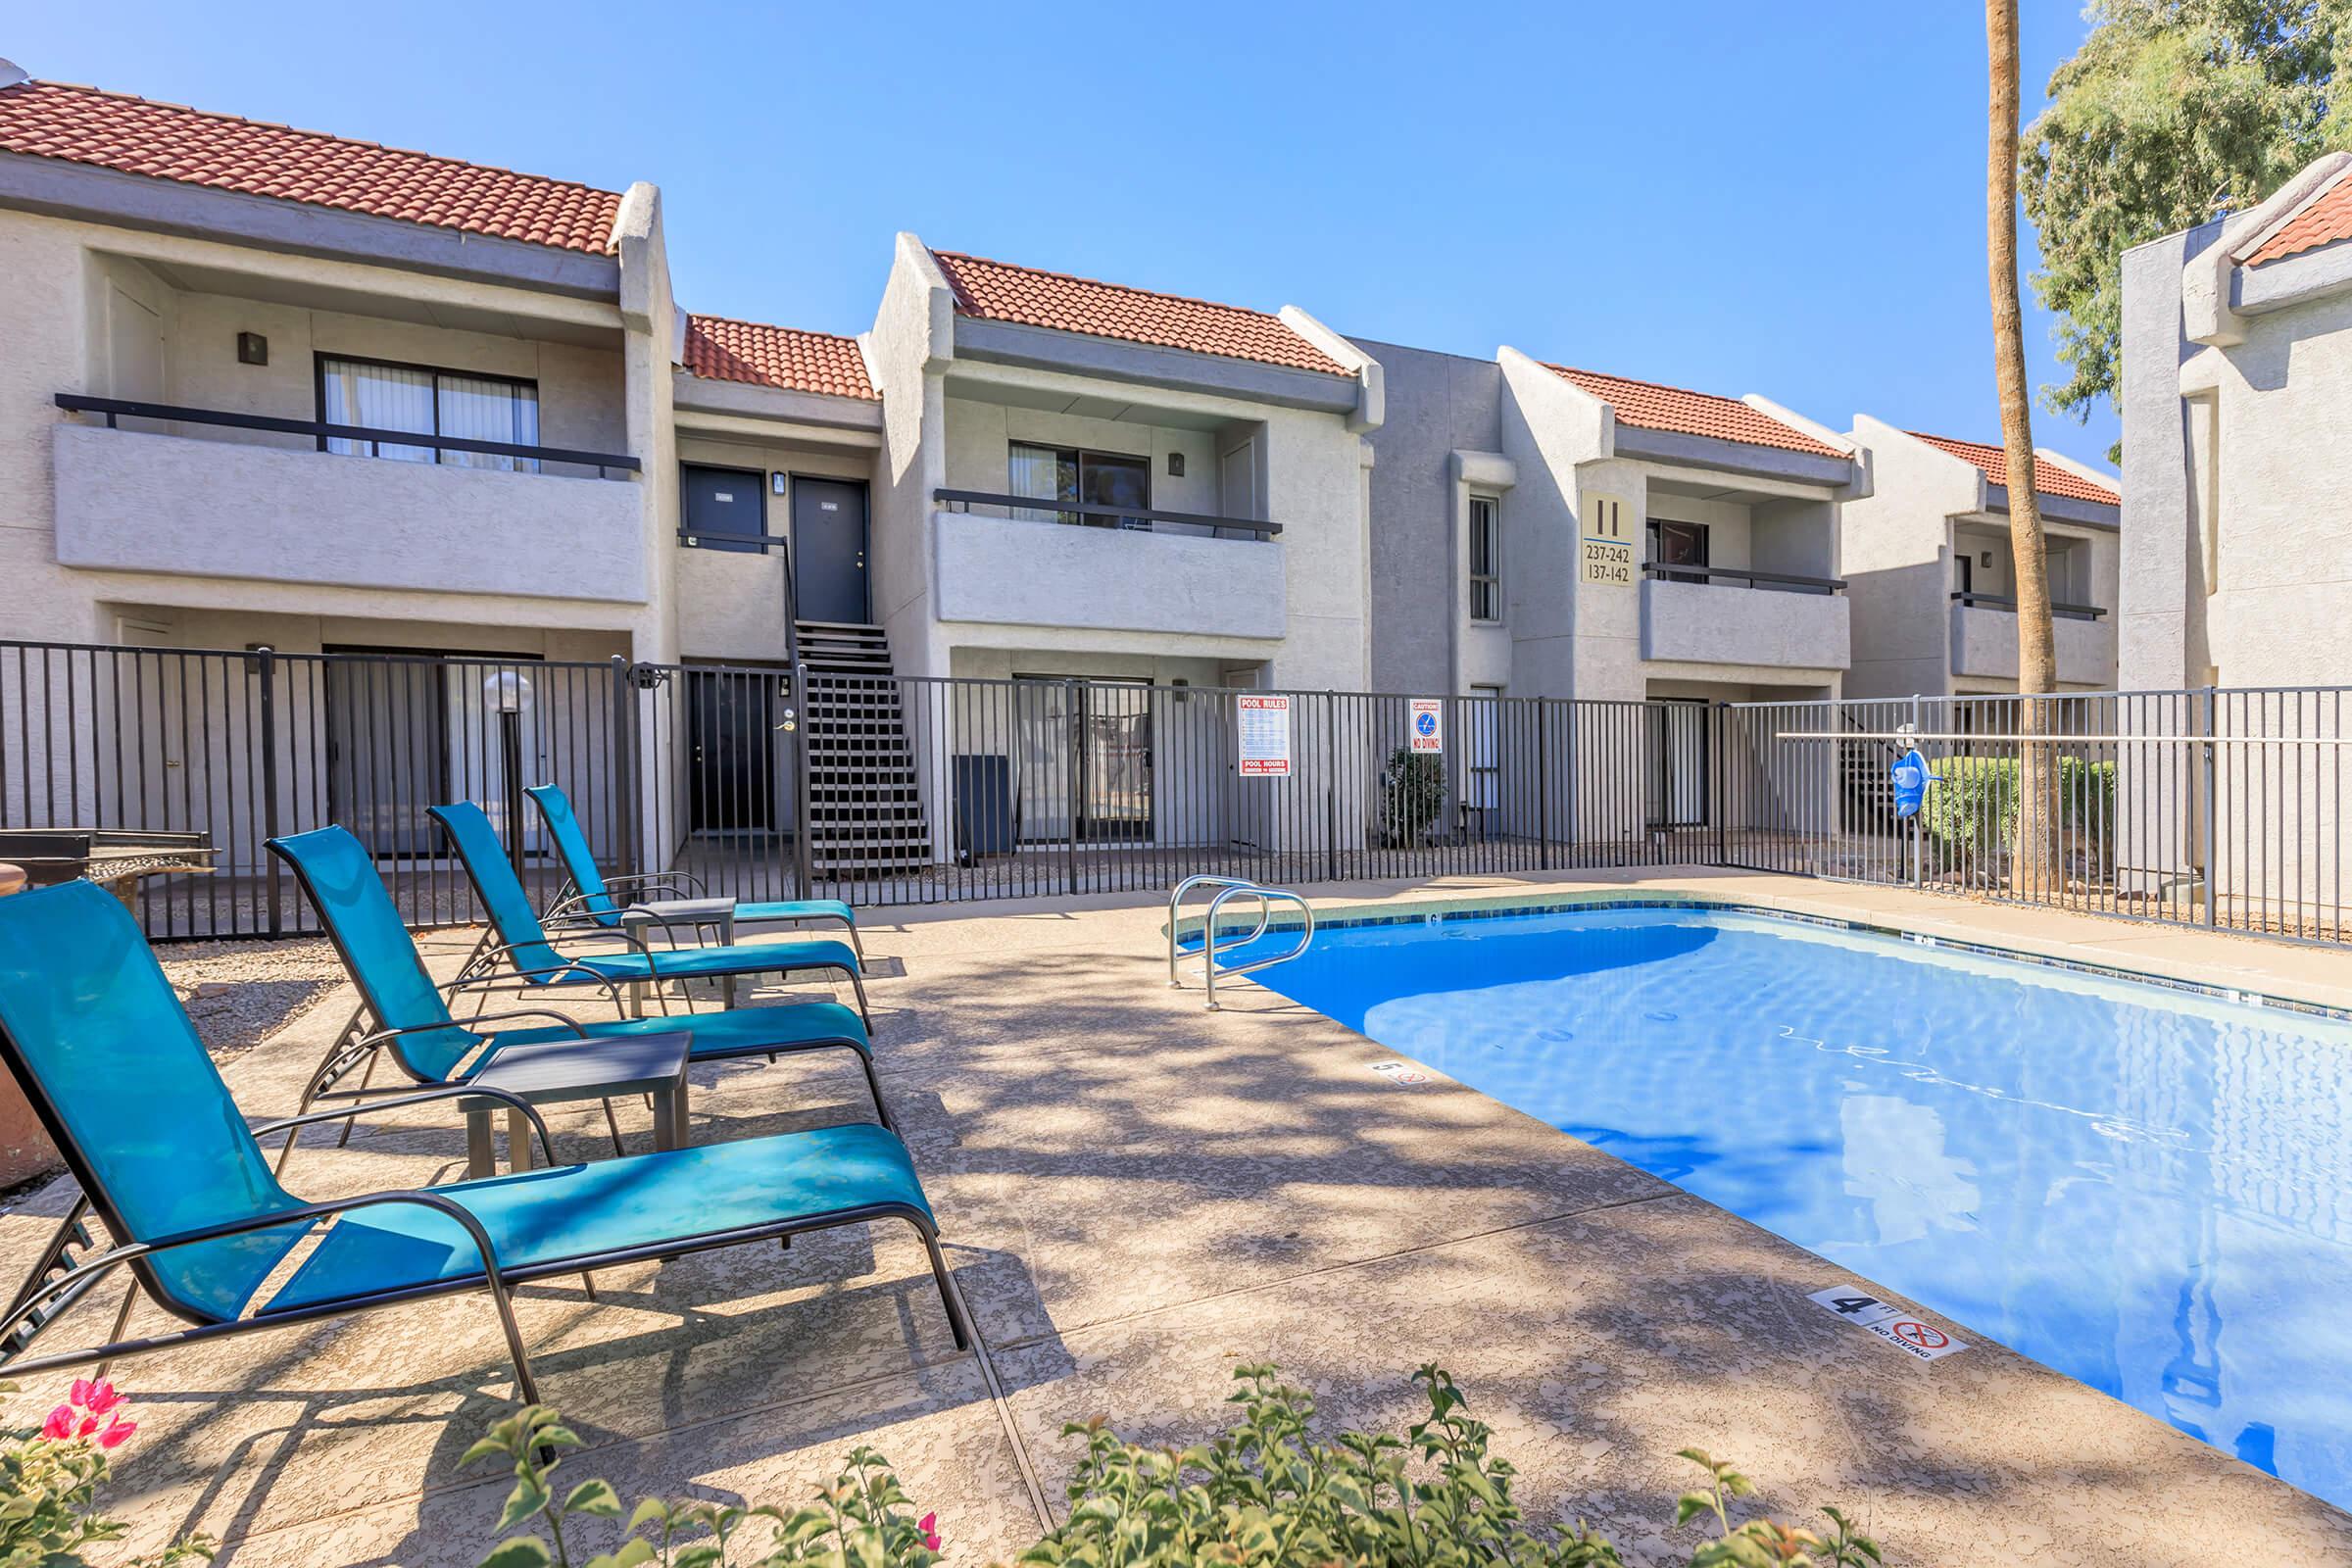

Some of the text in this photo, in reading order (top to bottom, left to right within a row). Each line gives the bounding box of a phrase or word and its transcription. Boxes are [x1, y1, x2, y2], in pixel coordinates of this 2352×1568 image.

[1597, 500, 1618, 536] 11
[1587, 545, 1630, 564] 237-242
[1589, 564, 1630, 582] 137-142
[1242, 699, 1286, 709] POOL RULES
[1413, 738, 1421, 749] NO
[1832, 1298, 1898, 1314] 4 FT
[1870, 1325, 1932, 1359] NO DIVING
